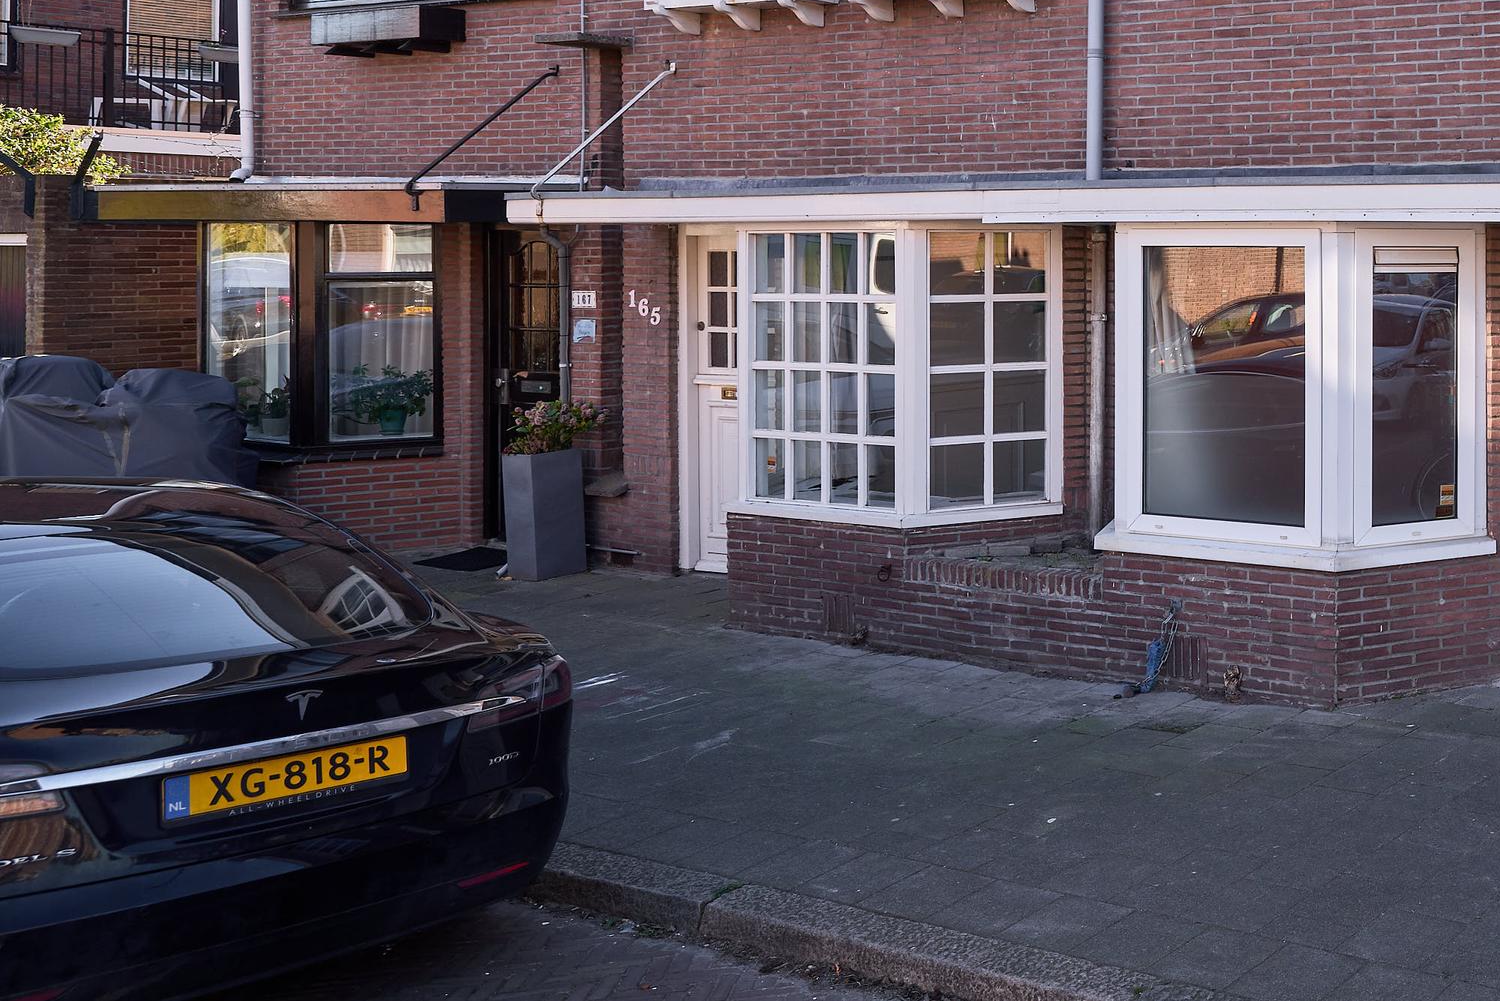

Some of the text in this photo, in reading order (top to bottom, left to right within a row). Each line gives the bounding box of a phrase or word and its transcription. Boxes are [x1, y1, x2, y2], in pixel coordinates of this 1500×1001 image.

[577, 294, 591, 305] 167
[628, 289, 661, 326] 165
[209, 745, 390, 806] XG-818-R
[168, 801, 187, 813] NL
